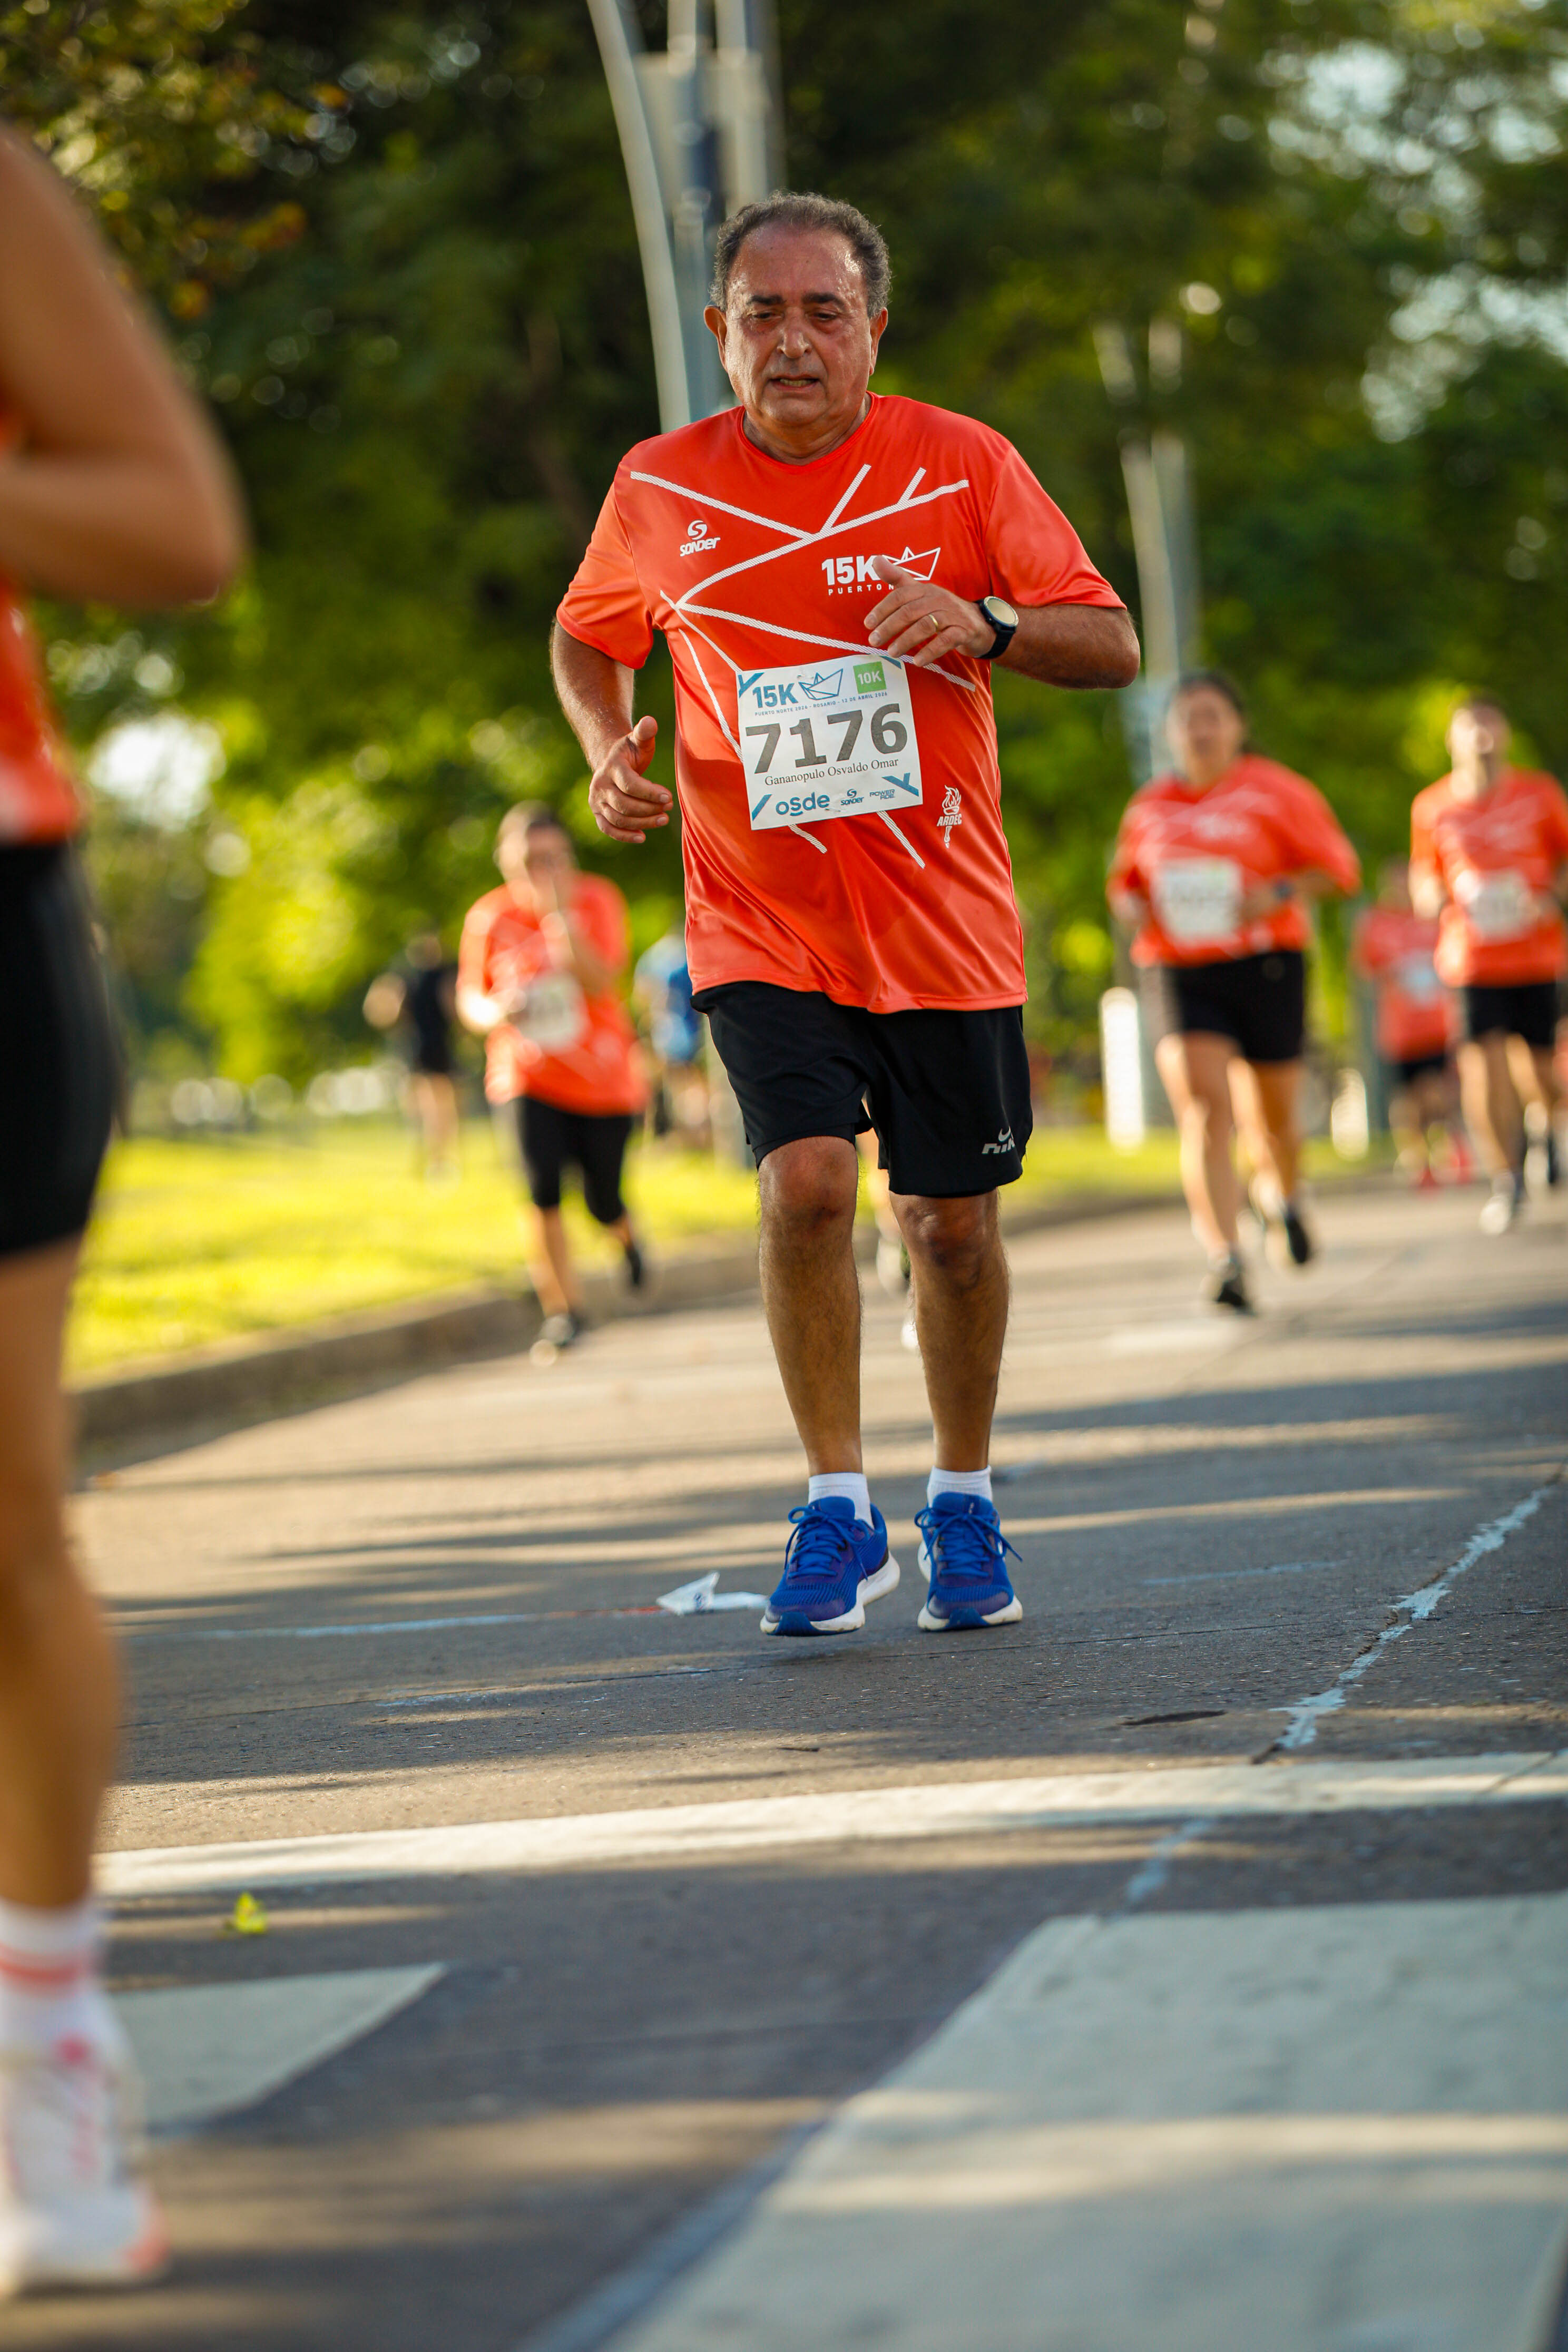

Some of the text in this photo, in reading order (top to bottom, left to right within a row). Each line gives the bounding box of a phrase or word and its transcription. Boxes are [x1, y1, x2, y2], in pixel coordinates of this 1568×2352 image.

[821, 555, 881, 586] 15K
[828, 584, 882, 596] PUERTO
[857, 670, 881, 684] 10K
[752, 683, 798, 708] 15K
[746, 703, 908, 774] 7176
[765, 759, 899, 785] Gananopulo Osvaldo Omar
[776, 792, 830, 815] osde
[936, 814, 962, 826] ARDEC
